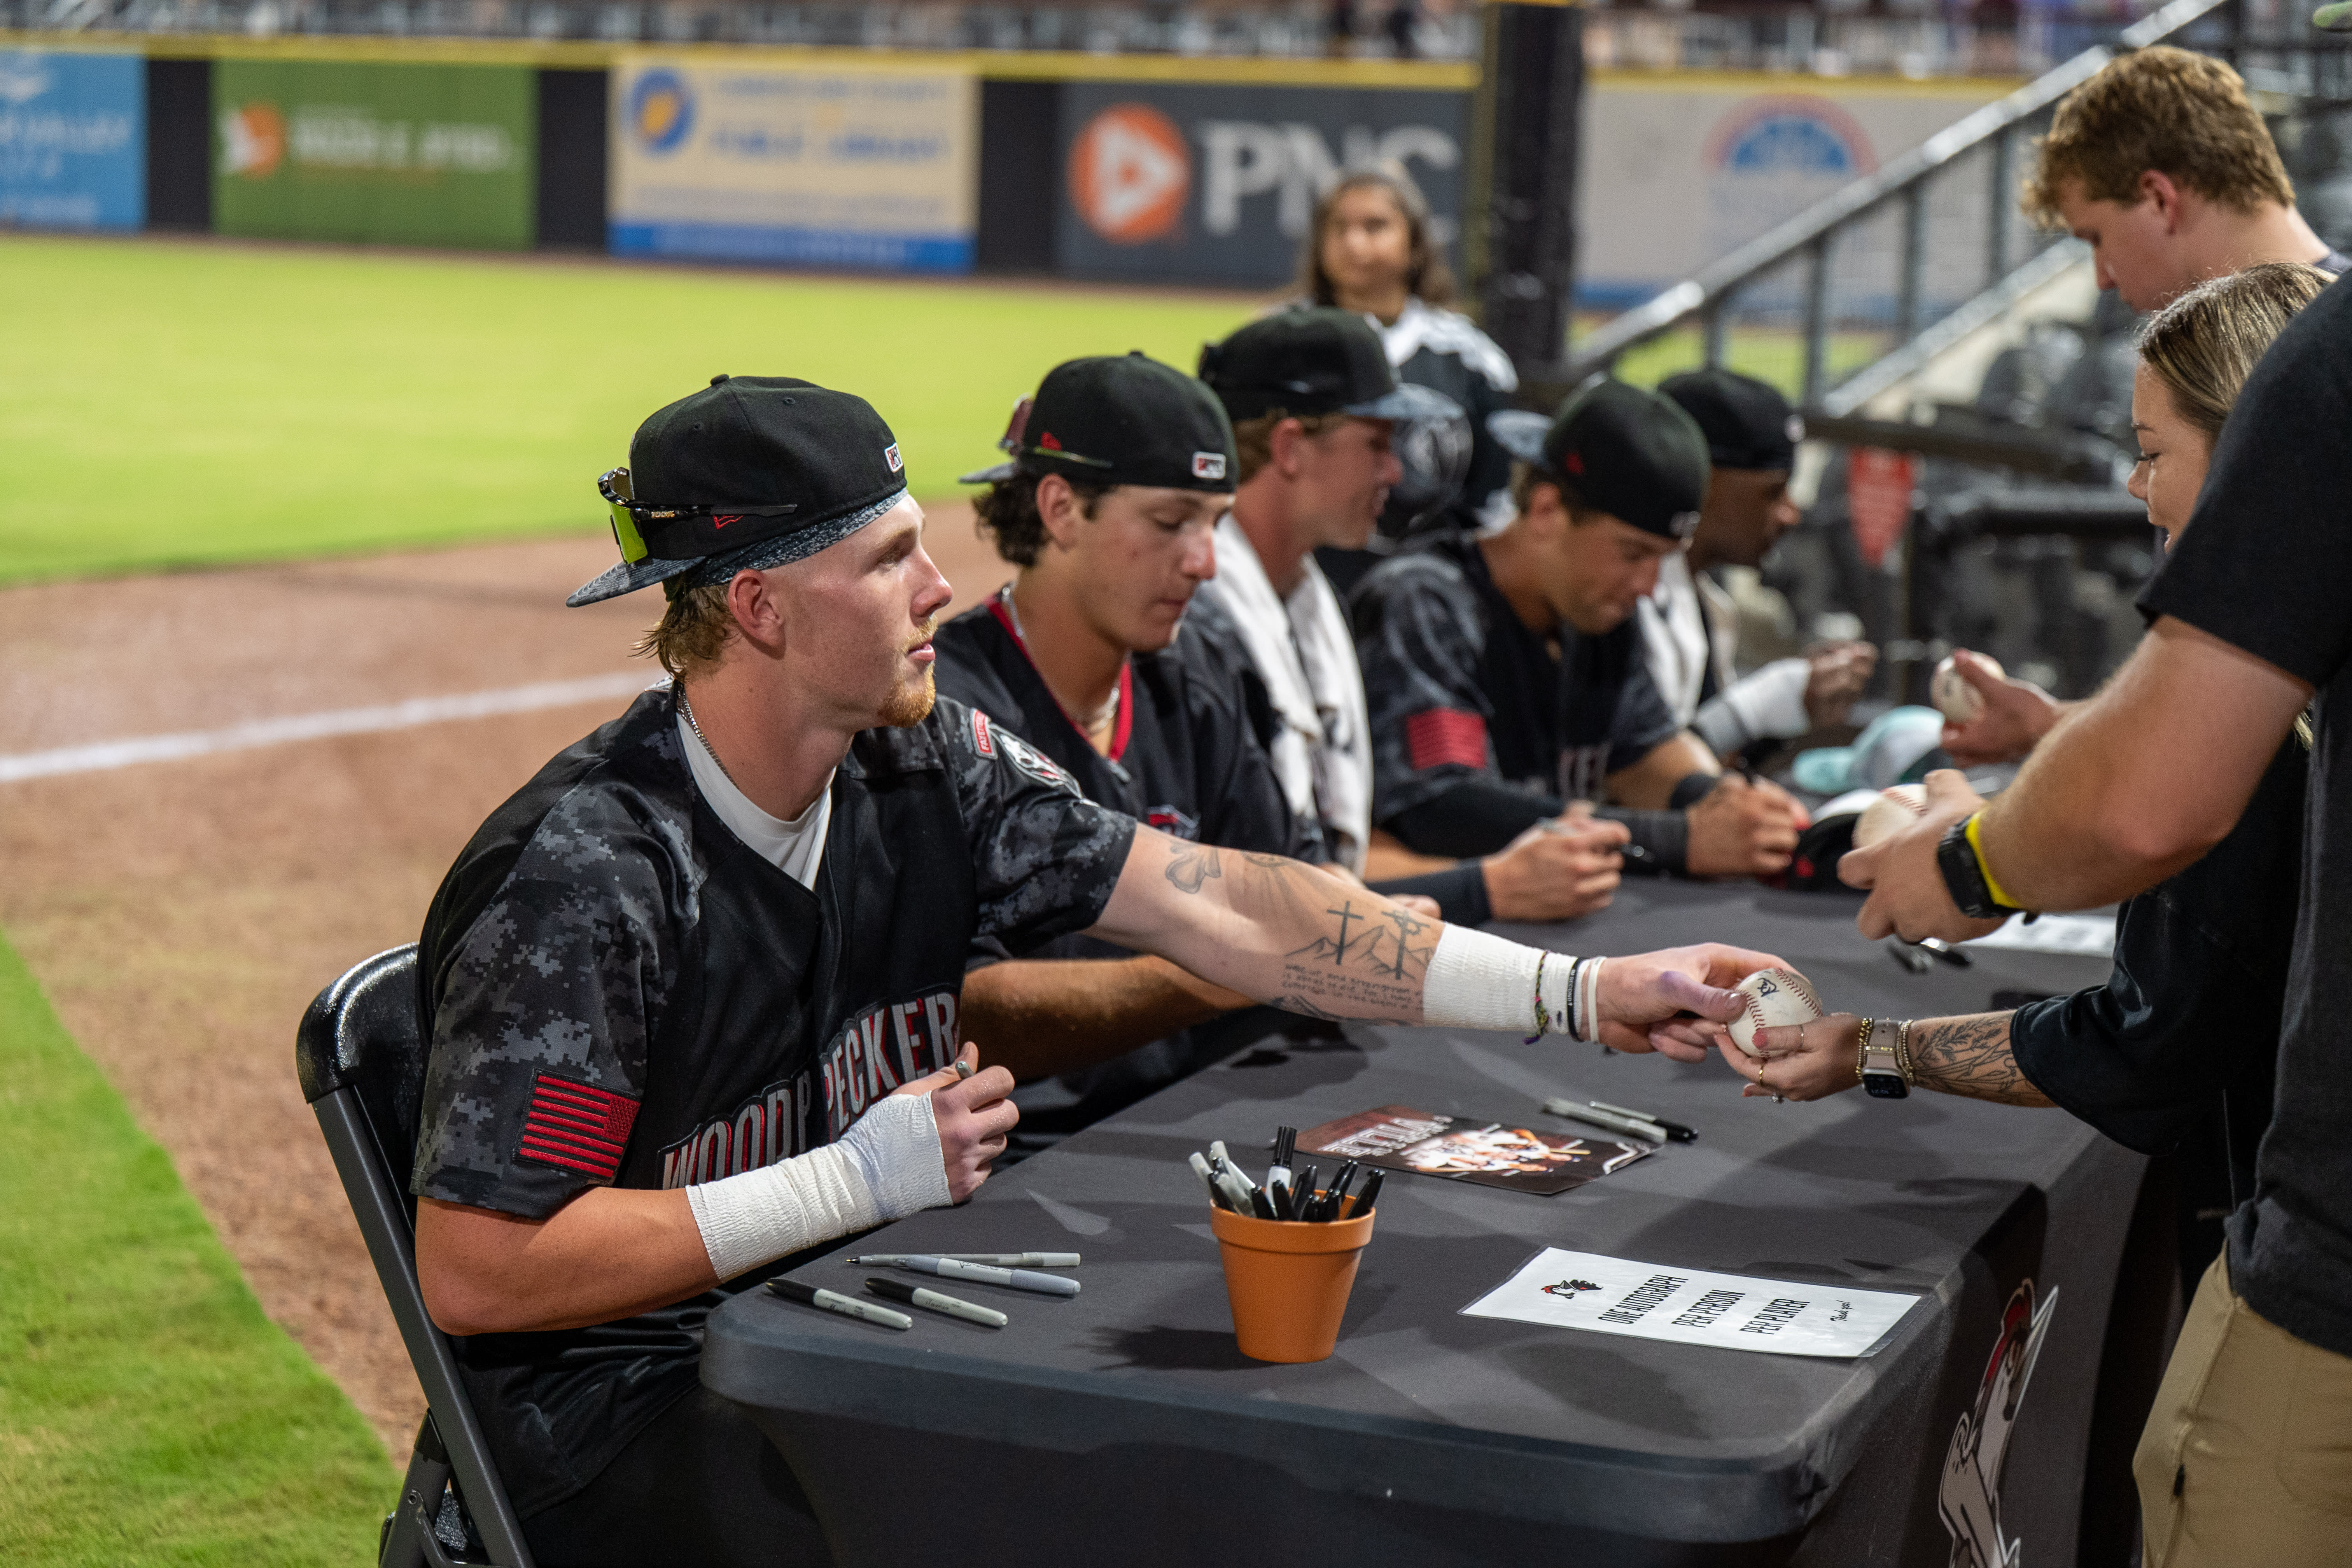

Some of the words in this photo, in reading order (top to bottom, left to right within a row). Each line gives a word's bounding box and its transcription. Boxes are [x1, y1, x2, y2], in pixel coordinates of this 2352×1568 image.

[1200, 120, 1461, 246] PNC
[1615, 1274, 1689, 1312] AUTOGRAPH
[1686, 1290, 1746, 1315] PERSON
[1598, 1309, 1645, 1324] ONE
[1754, 1298, 1810, 1322] PLAYER
[1830, 1309, 1849, 1321] Thank
[1671, 1314, 1717, 1328] PER
[1739, 1321, 1785, 1335] PER
